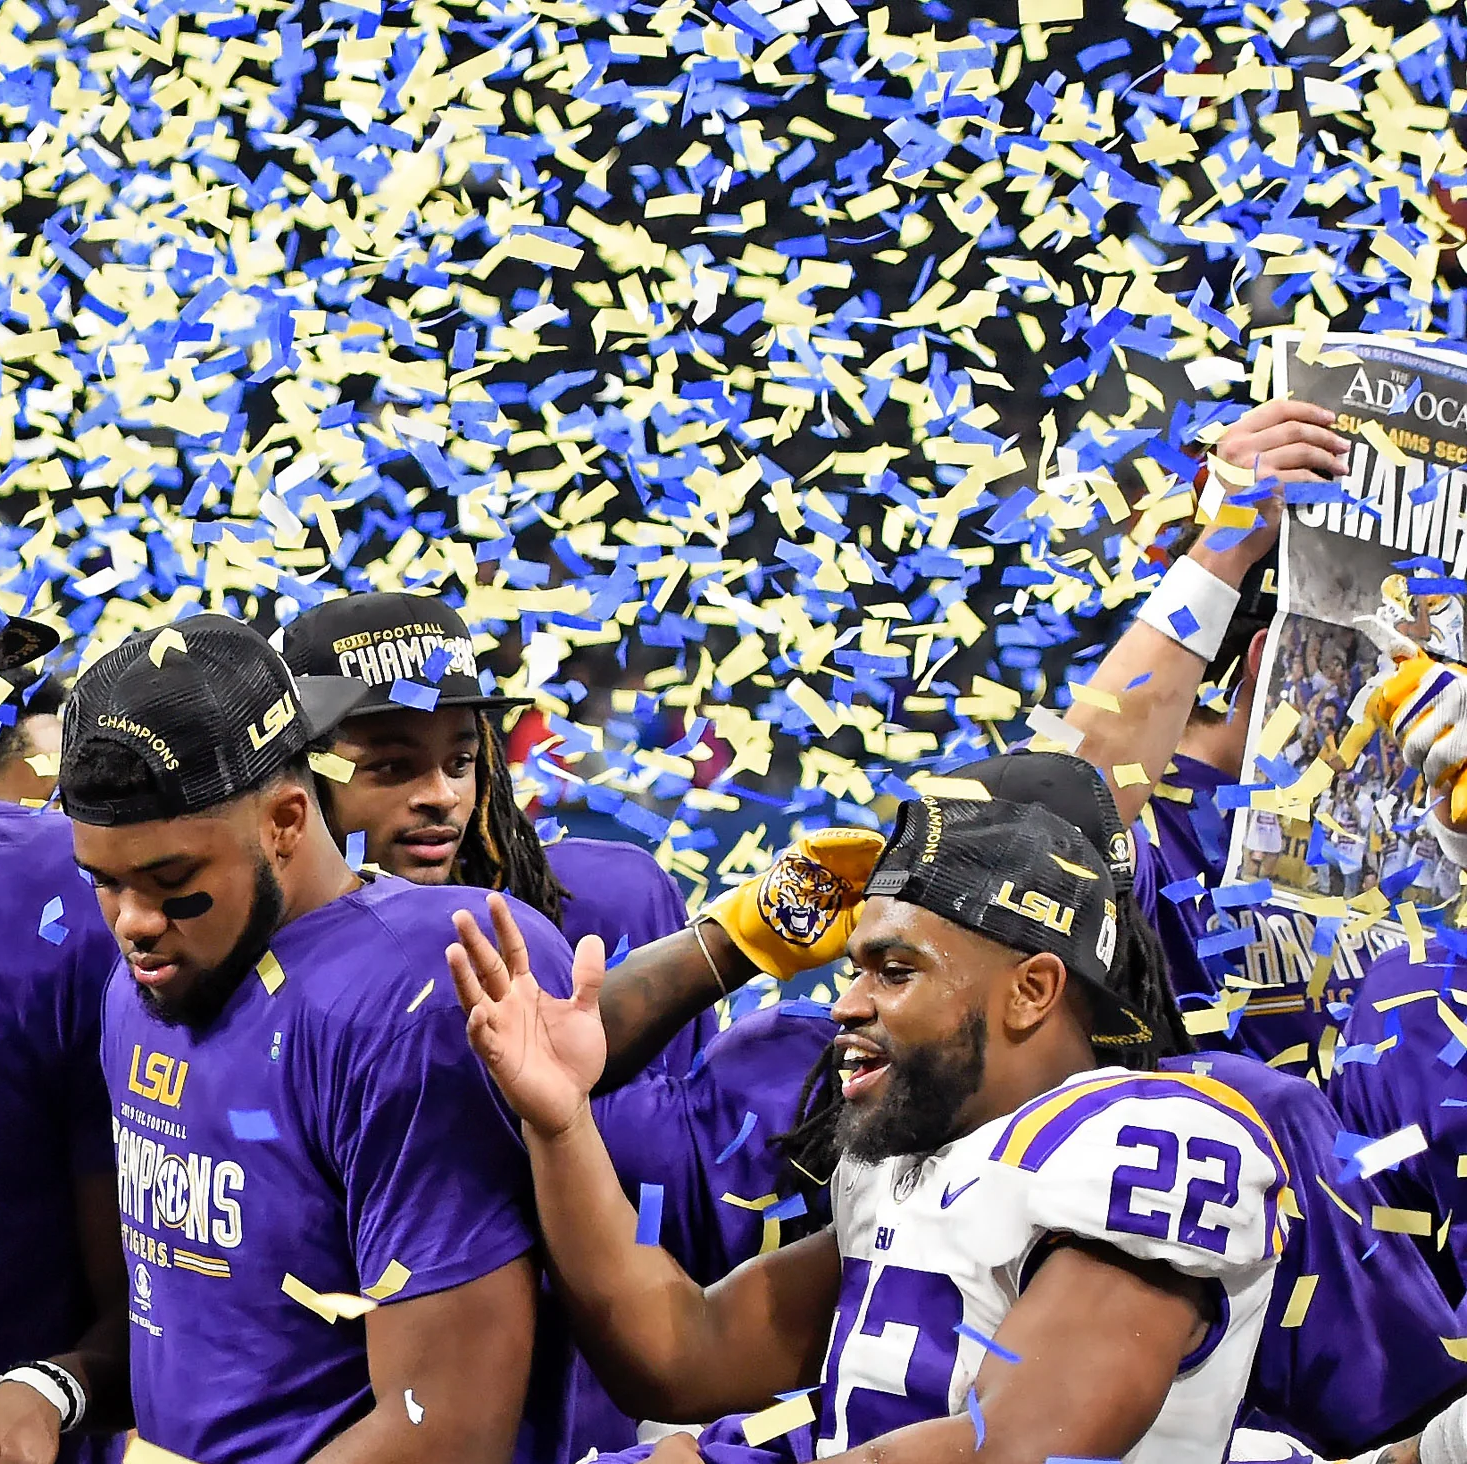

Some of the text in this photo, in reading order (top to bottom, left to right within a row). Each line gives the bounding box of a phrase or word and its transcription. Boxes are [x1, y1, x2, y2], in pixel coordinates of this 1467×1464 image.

[333, 622, 445, 654] 2019 FOOTBALL
[97, 714, 180, 771] CHAMPIONS
[247, 690, 297, 751] LSU
[995, 880, 1074, 936] LSU
[128, 1044, 189, 1107] LSU
[147, 1113, 188, 1140] FOOTBALL
[1106, 1124, 1241, 1255] 22
